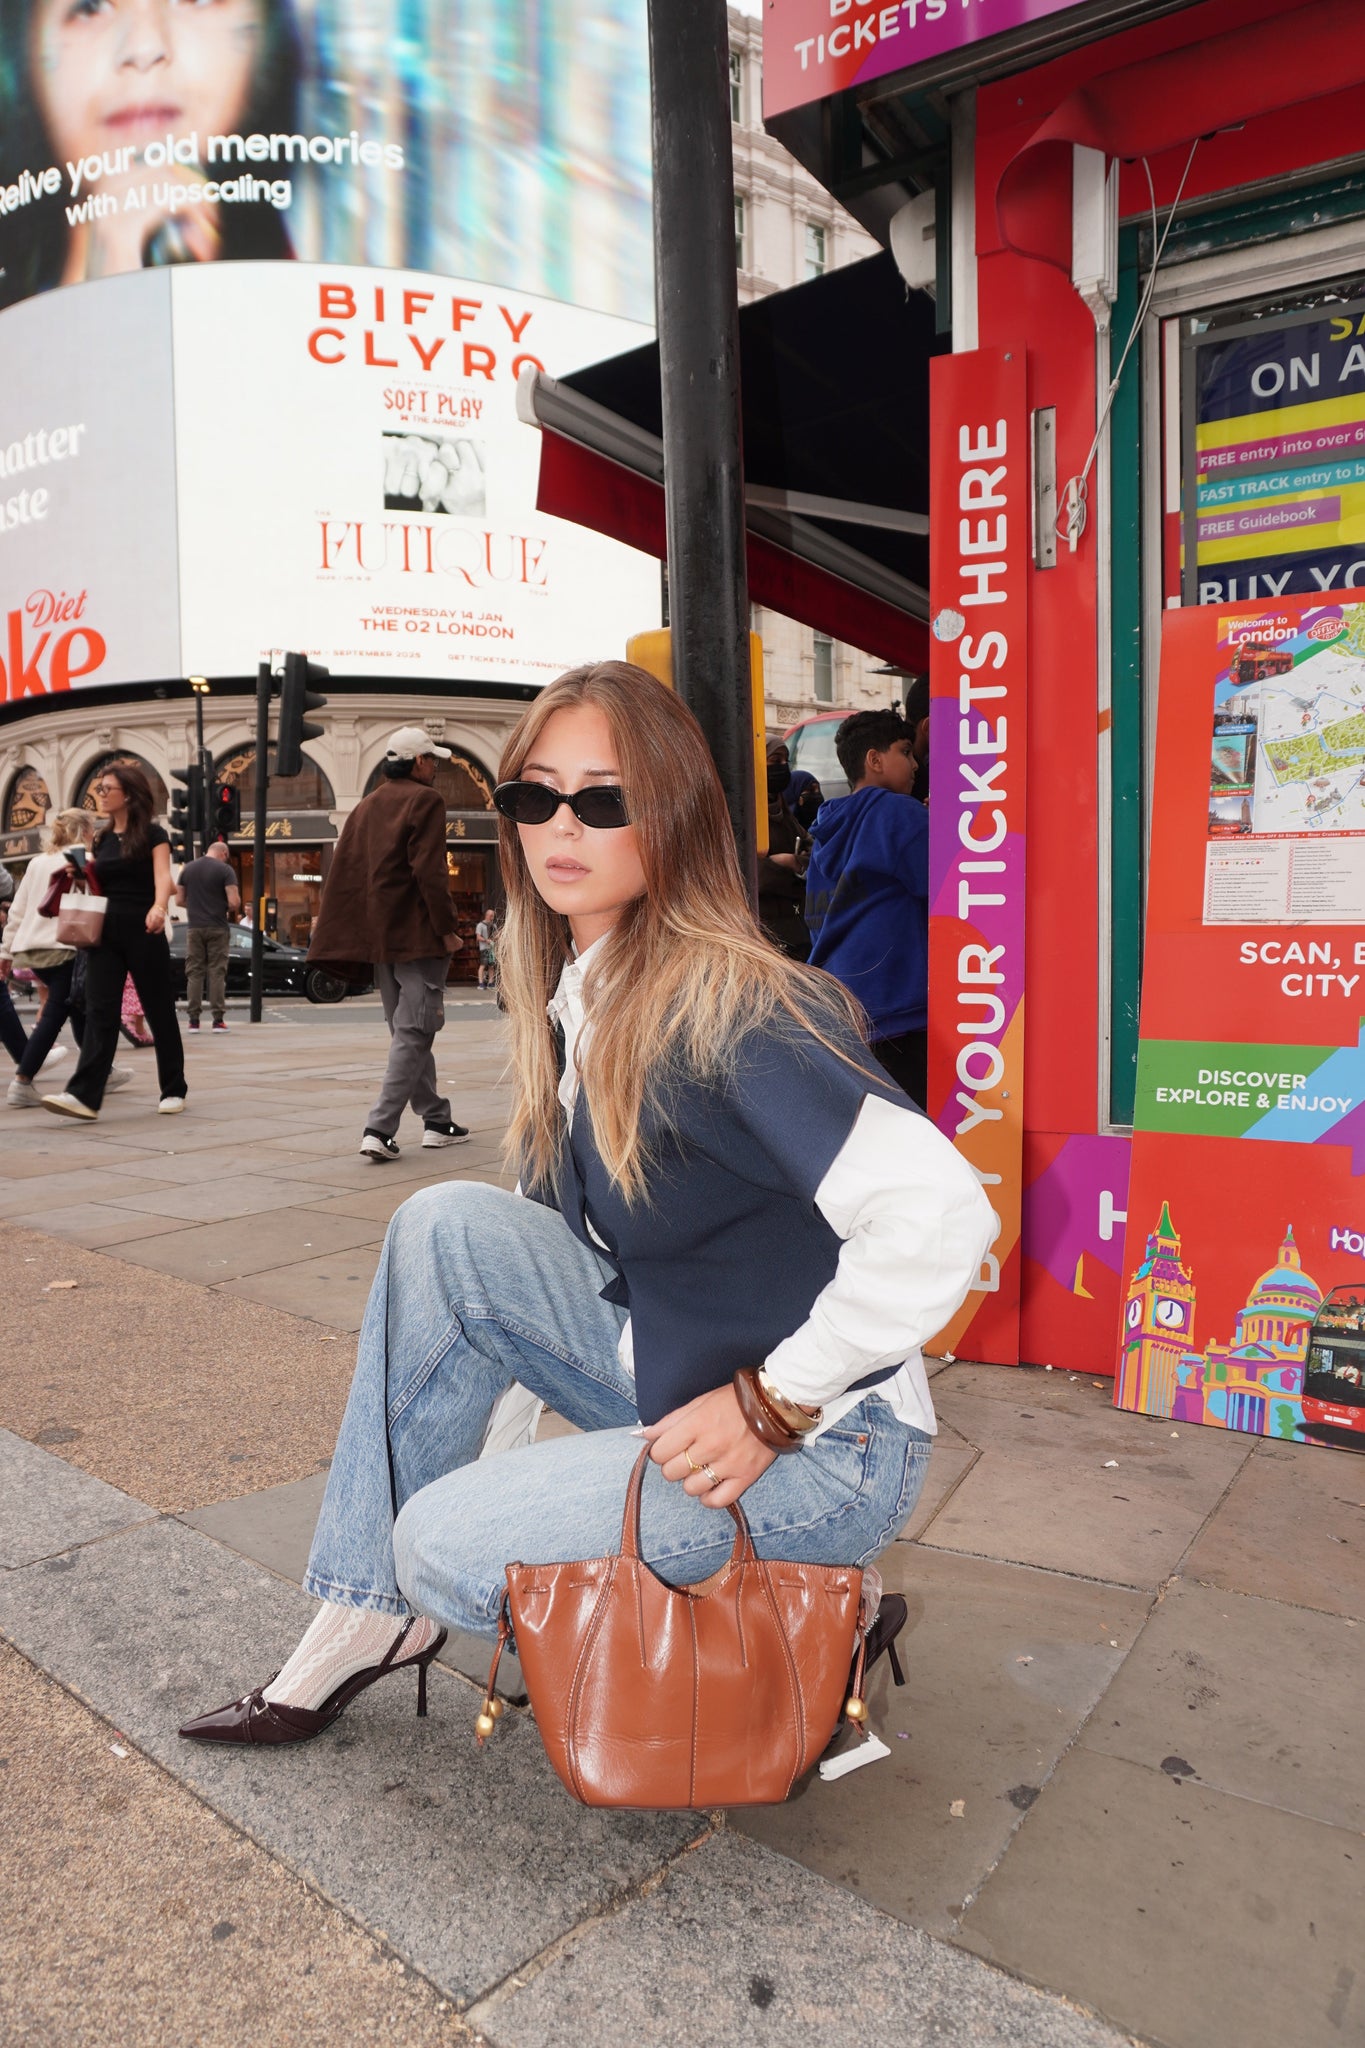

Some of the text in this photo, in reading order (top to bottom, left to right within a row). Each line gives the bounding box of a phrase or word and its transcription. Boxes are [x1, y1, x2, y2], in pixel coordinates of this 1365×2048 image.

[66, 144, 136, 197] your
[143, 131, 198, 168] old
[206, 130, 404, 171] memories
[65, 173, 292, 226] with AI Upscaling
[318, 282, 534, 344] BIFFY
[1251, 352, 1321, 398] ON
[383, 388, 483, 420] SOFT PLAY
[1200, 451, 1236, 469] FREE
[1239, 444, 1278, 461] entry
[1282, 440, 1313, 454] into
[1316, 432, 1351, 448] over
[1200, 485, 1234, 503] FAST
[1239, 477, 1290, 497] TRACK
[1293, 470, 1332, 489] entry
[1336, 467, 1351, 480] to
[959, 419, 1008, 606] HERE
[1200, 507, 1317, 536] FREE Guidebook
[317, 521, 549, 589] FUTIQUE
[25, 588, 88, 628] Diet
[371, 605, 503, 622] WEDNESDAY 14 JAN
[1228, 616, 1288, 630] Welcome to
[360, 618, 398, 631] THE
[436, 623, 514, 640] LONDON
[1228, 626, 1299, 646] London
[1311, 621, 1347, 638] OFFICIAL
[0, 609, 107, 704] ke
[959, 630, 1008, 922] TICKETS
[1239, 942, 1341, 970] SCAN,
[1281, 974, 1360, 998] CITY
[955, 944, 1006, 1135] YOUR
[1198, 1069, 1307, 1090] DISCOVER
[1156, 1088, 1352, 1113] EXPLORE & ENJOY
